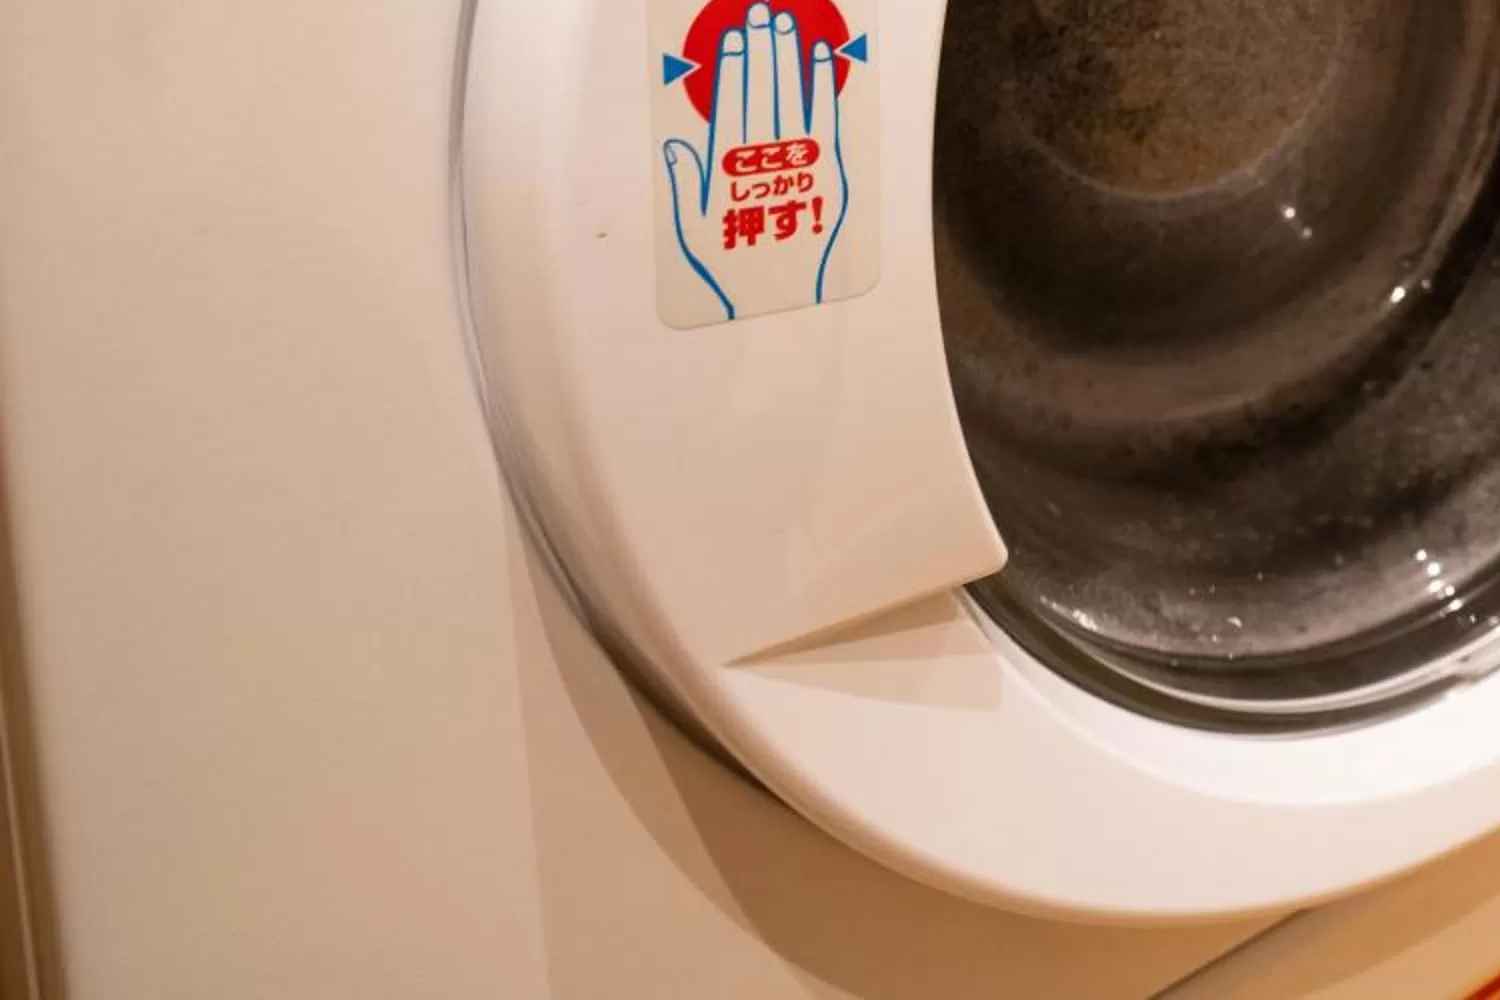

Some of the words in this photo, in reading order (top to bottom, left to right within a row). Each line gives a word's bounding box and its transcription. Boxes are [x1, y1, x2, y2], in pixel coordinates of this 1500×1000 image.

[735, 142, 809, 172] ここを
[730, 171, 814, 202] しっかり
[723, 196, 823, 250] 押す!
